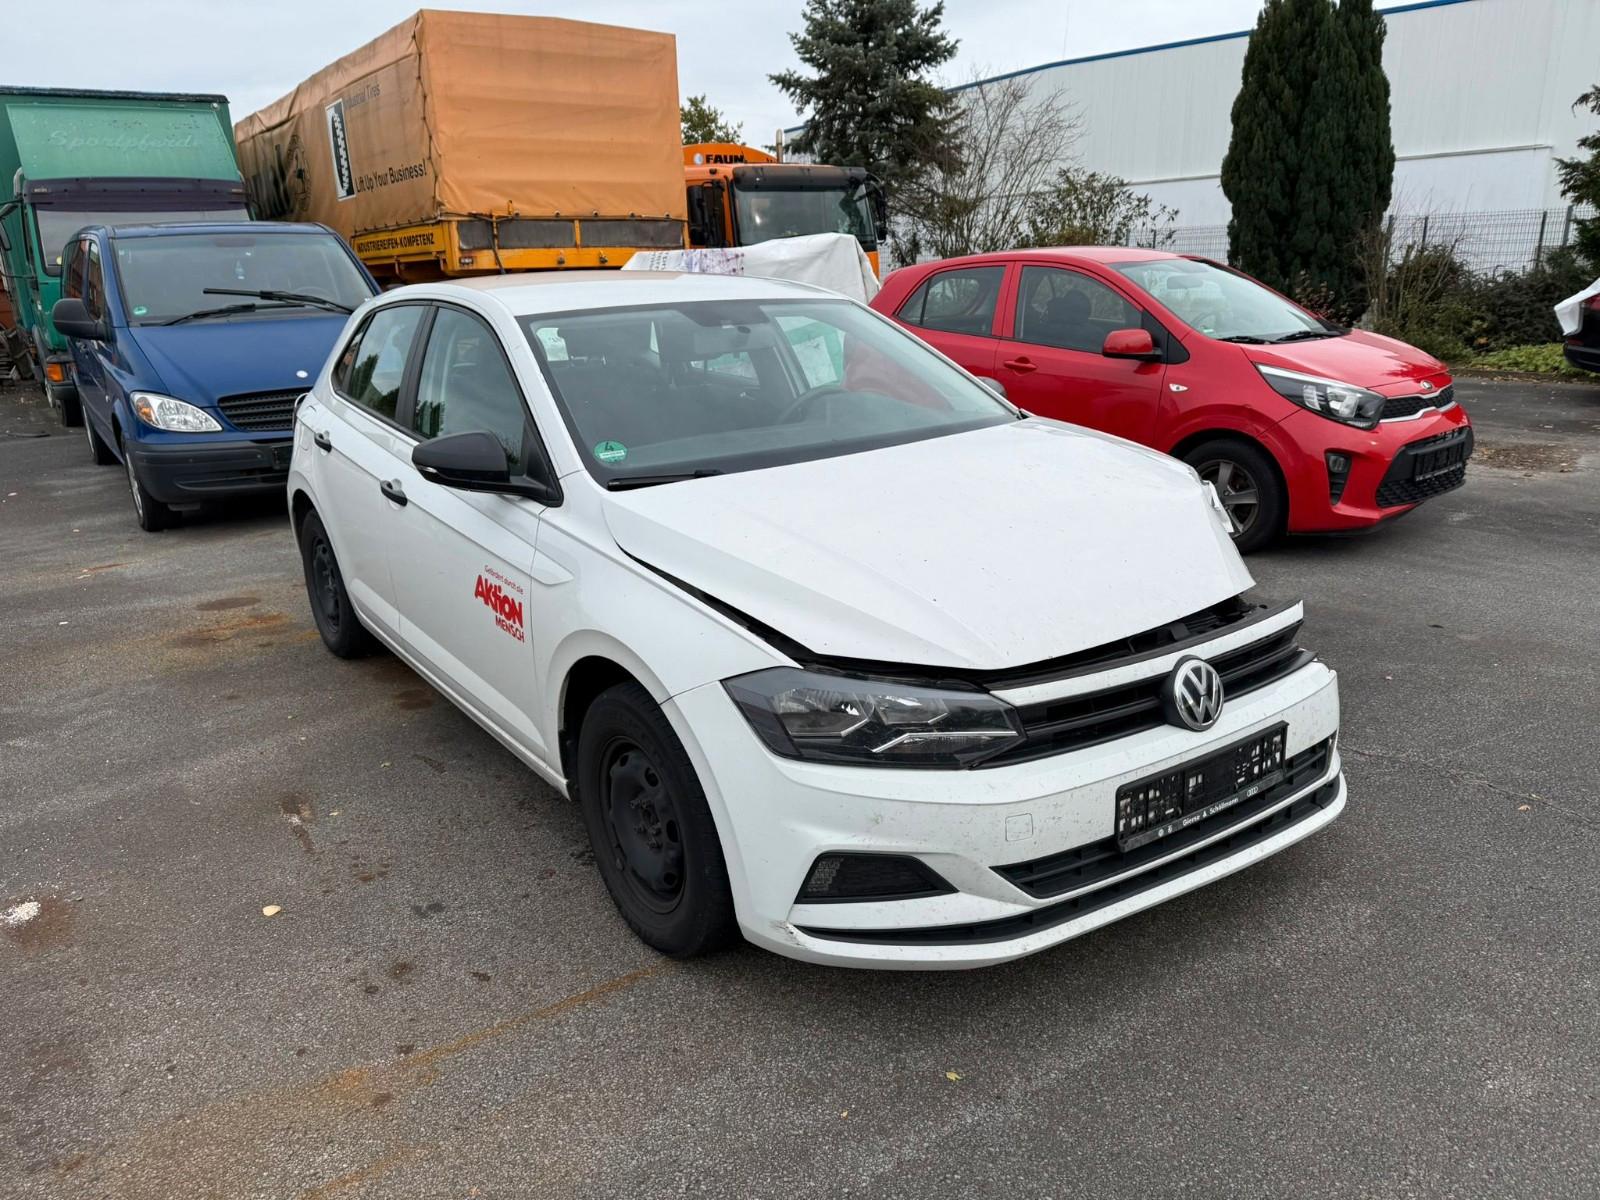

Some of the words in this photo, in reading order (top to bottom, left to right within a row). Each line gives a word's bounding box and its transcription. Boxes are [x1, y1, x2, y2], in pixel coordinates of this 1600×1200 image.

[706, 154, 744, 164] FAUN
[354, 176, 366, 193] Lift
[364, 174, 374, 192] Up
[372, 170, 388, 188] Your
[388, 159, 427, 184] Business!
[495, 614, 525, 643] MENSCH
